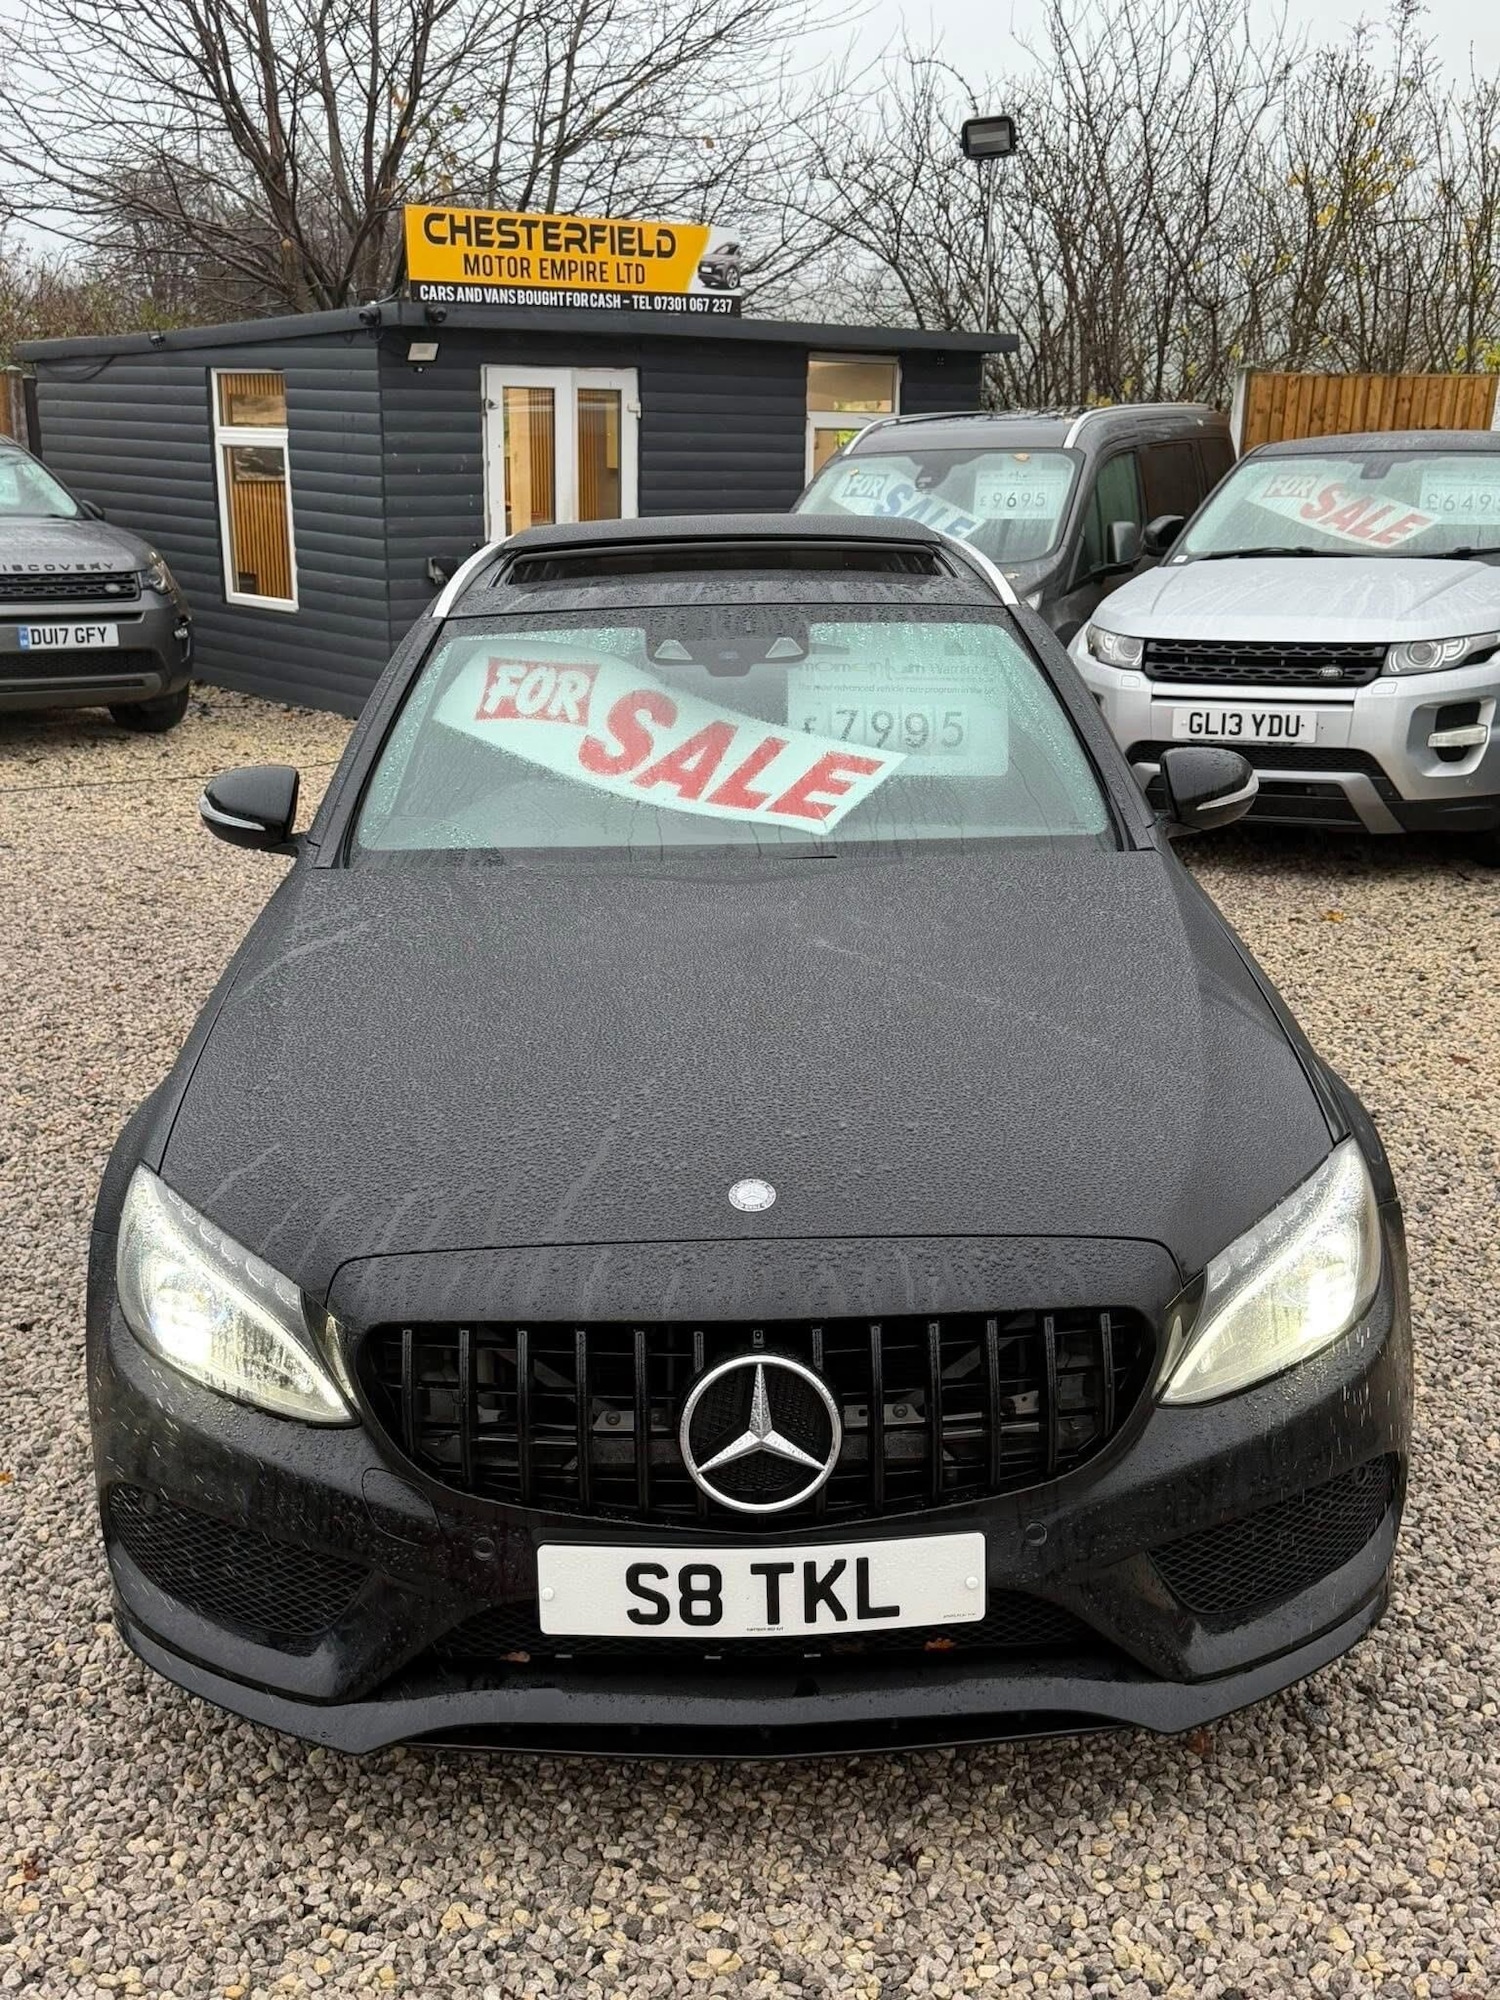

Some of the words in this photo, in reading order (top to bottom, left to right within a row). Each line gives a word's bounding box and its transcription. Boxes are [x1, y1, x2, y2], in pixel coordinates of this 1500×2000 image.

[424, 213, 676, 258] CHESTERFIELD
[464, 254, 531, 278] MOTOR
[539, 258, 609, 283] EMPIRE
[616, 262, 645, 284] LTD
[420, 285, 455, 301] CARS
[456, 286, 482, 303] AND
[484, 288, 518, 304] VANS
[518, 289, 566, 306] BOUGHT
[566, 291, 589, 308] FOR
[590, 293, 621, 308] CASH
[632, 295, 654, 310] TEL
[654, 296, 686, 311] 07301
[689, 298, 709, 312] 067
[712, 299, 732, 313] 237
[845, 475, 882, 498] FOR
[1267, 476, 1313, 497] FOR
[874, 484, 976, 537] SALE
[1301, 483, 1432, 546] SALE
[1427, 493, 1500, 513] £649
[2, 563, 114, 572] ISCOVERY
[31, 627, 69, 645] DU17
[75, 626, 108, 644] GFY
[483, 664, 583, 723] FOR
[1189, 712, 1242, 735] GL13
[1252, 713, 1301, 737] YDU
[578, 690, 885, 820] SALE
[625, 1562, 723, 1626] S8
[750, 1557, 900, 1625] TKL
